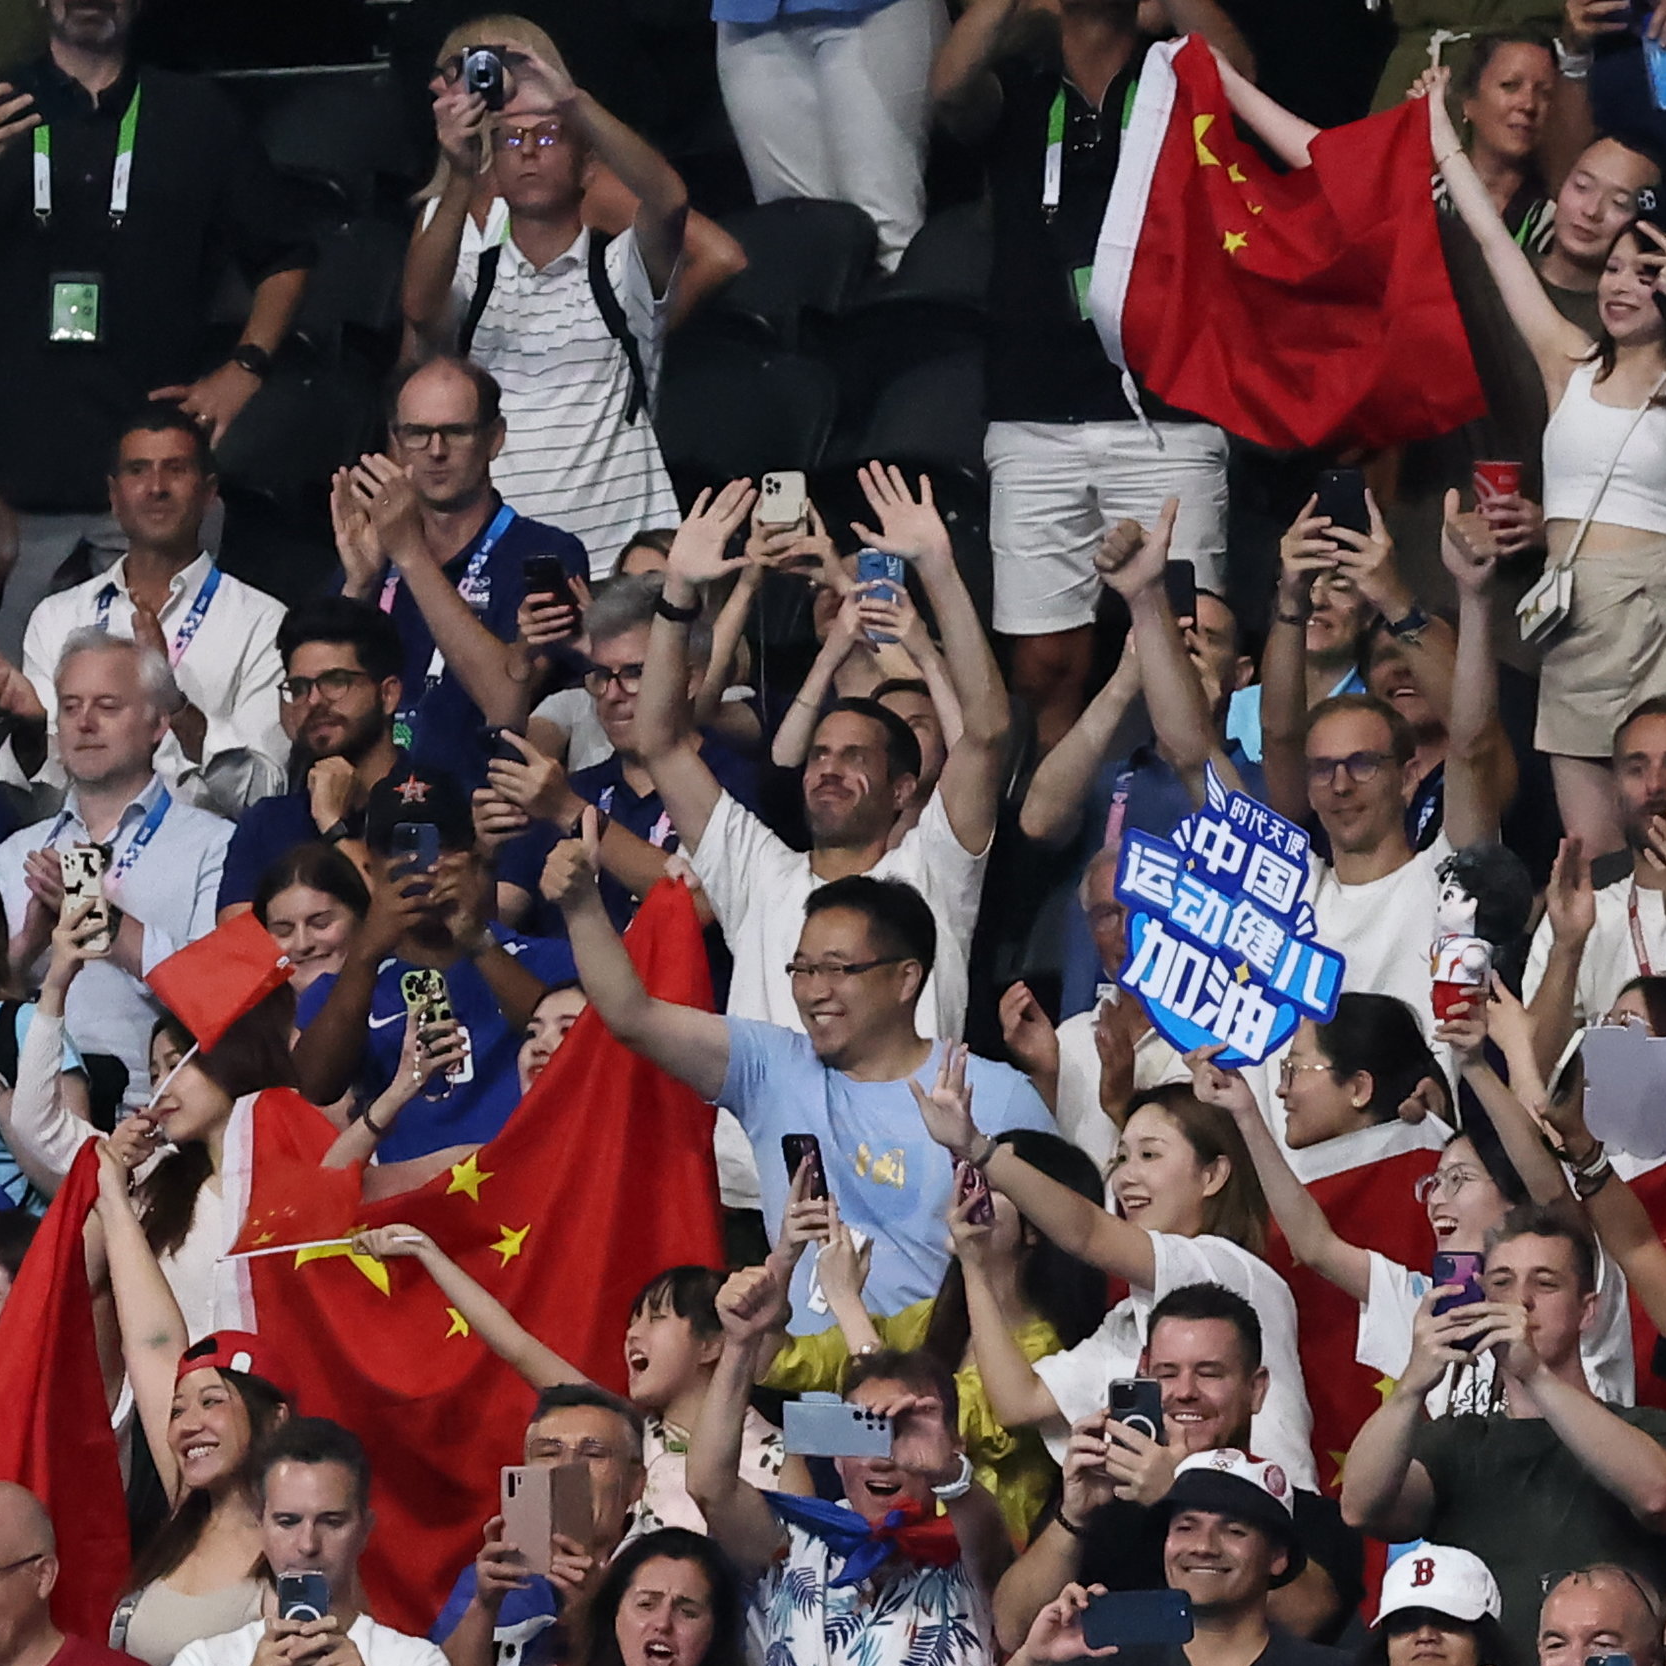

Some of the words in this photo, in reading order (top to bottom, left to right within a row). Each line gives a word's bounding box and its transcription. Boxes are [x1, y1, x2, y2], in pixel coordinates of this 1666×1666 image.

[1193, 816, 1303, 916] 中国
[1229, 796, 1307, 860] 时代天使
[1120, 840, 1341, 1016] 运动健儿
[1121, 918, 1277, 1062] 加油
